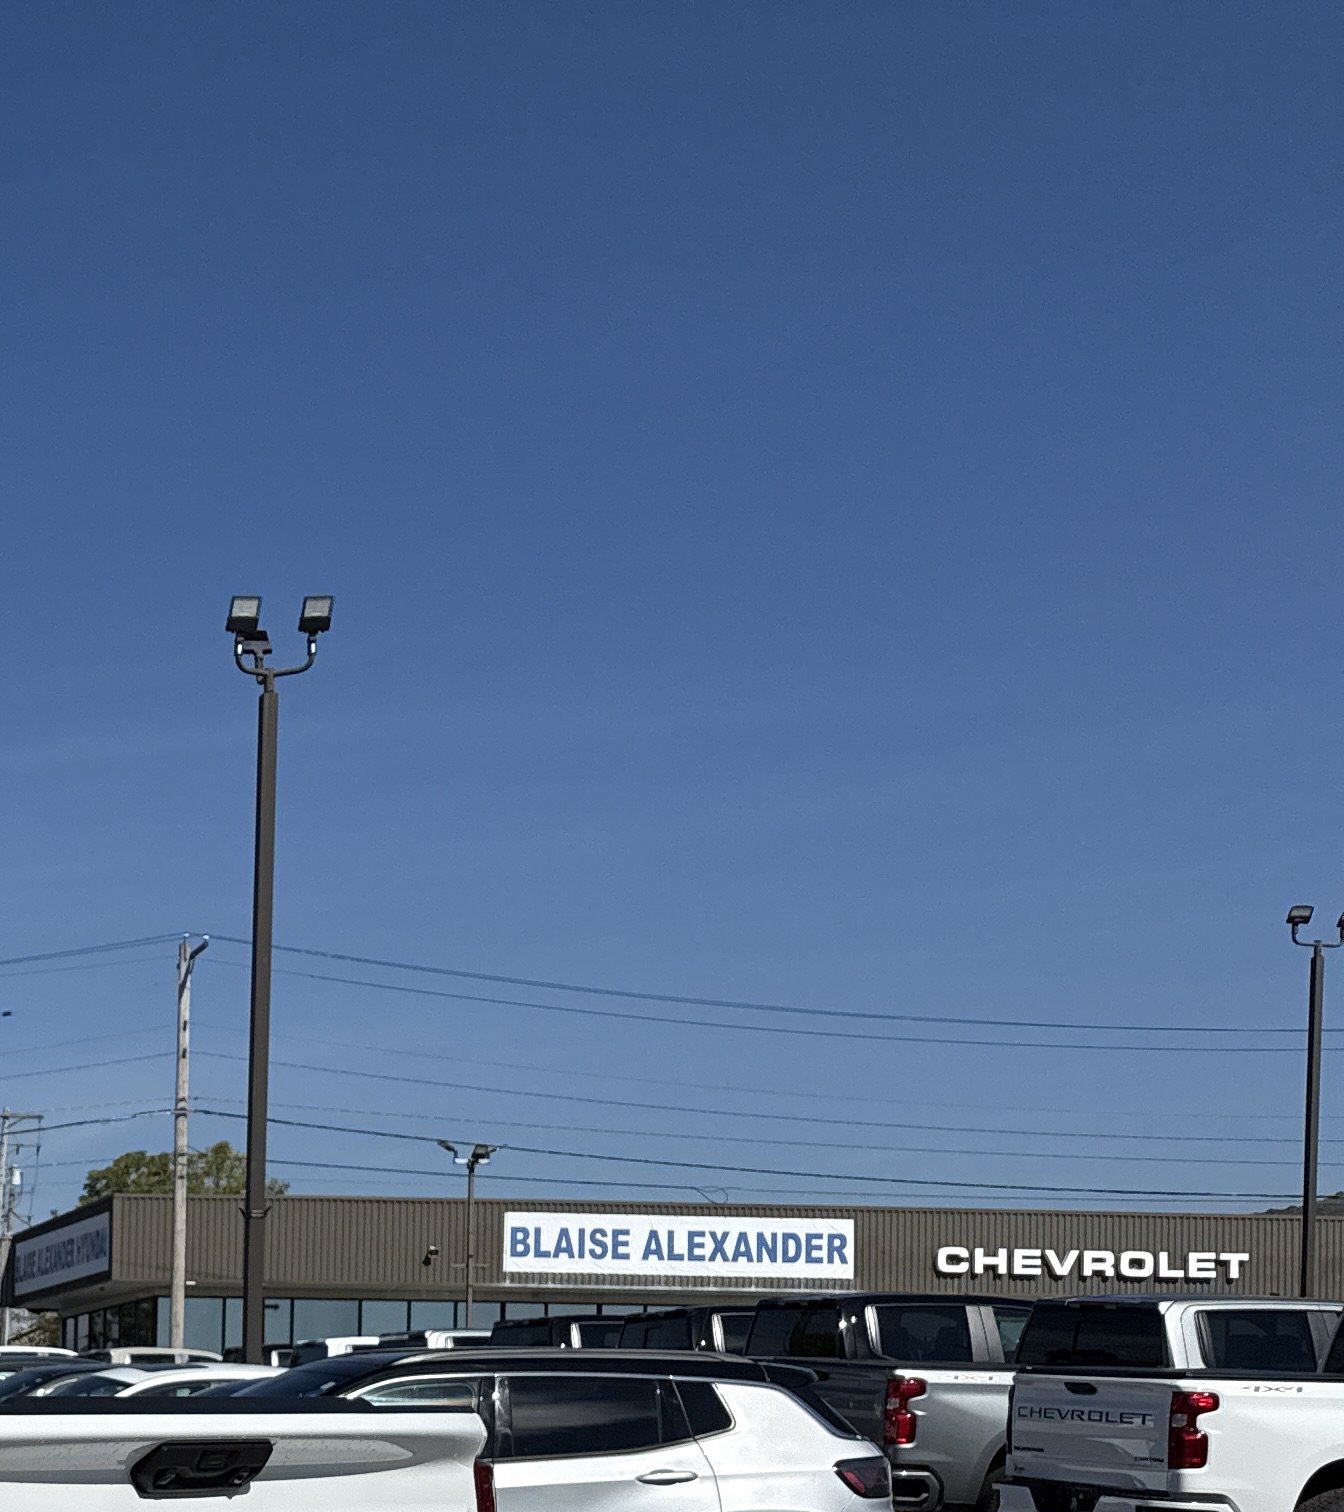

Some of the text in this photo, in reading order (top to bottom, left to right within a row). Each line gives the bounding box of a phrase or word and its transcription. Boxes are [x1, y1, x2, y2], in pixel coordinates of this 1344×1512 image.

[510, 1225, 849, 1264] BLAISE ALEXANDER
[936, 1246, 1250, 1280] CHEVROLET
[1016, 1405, 1153, 1426] CHEVROLET
